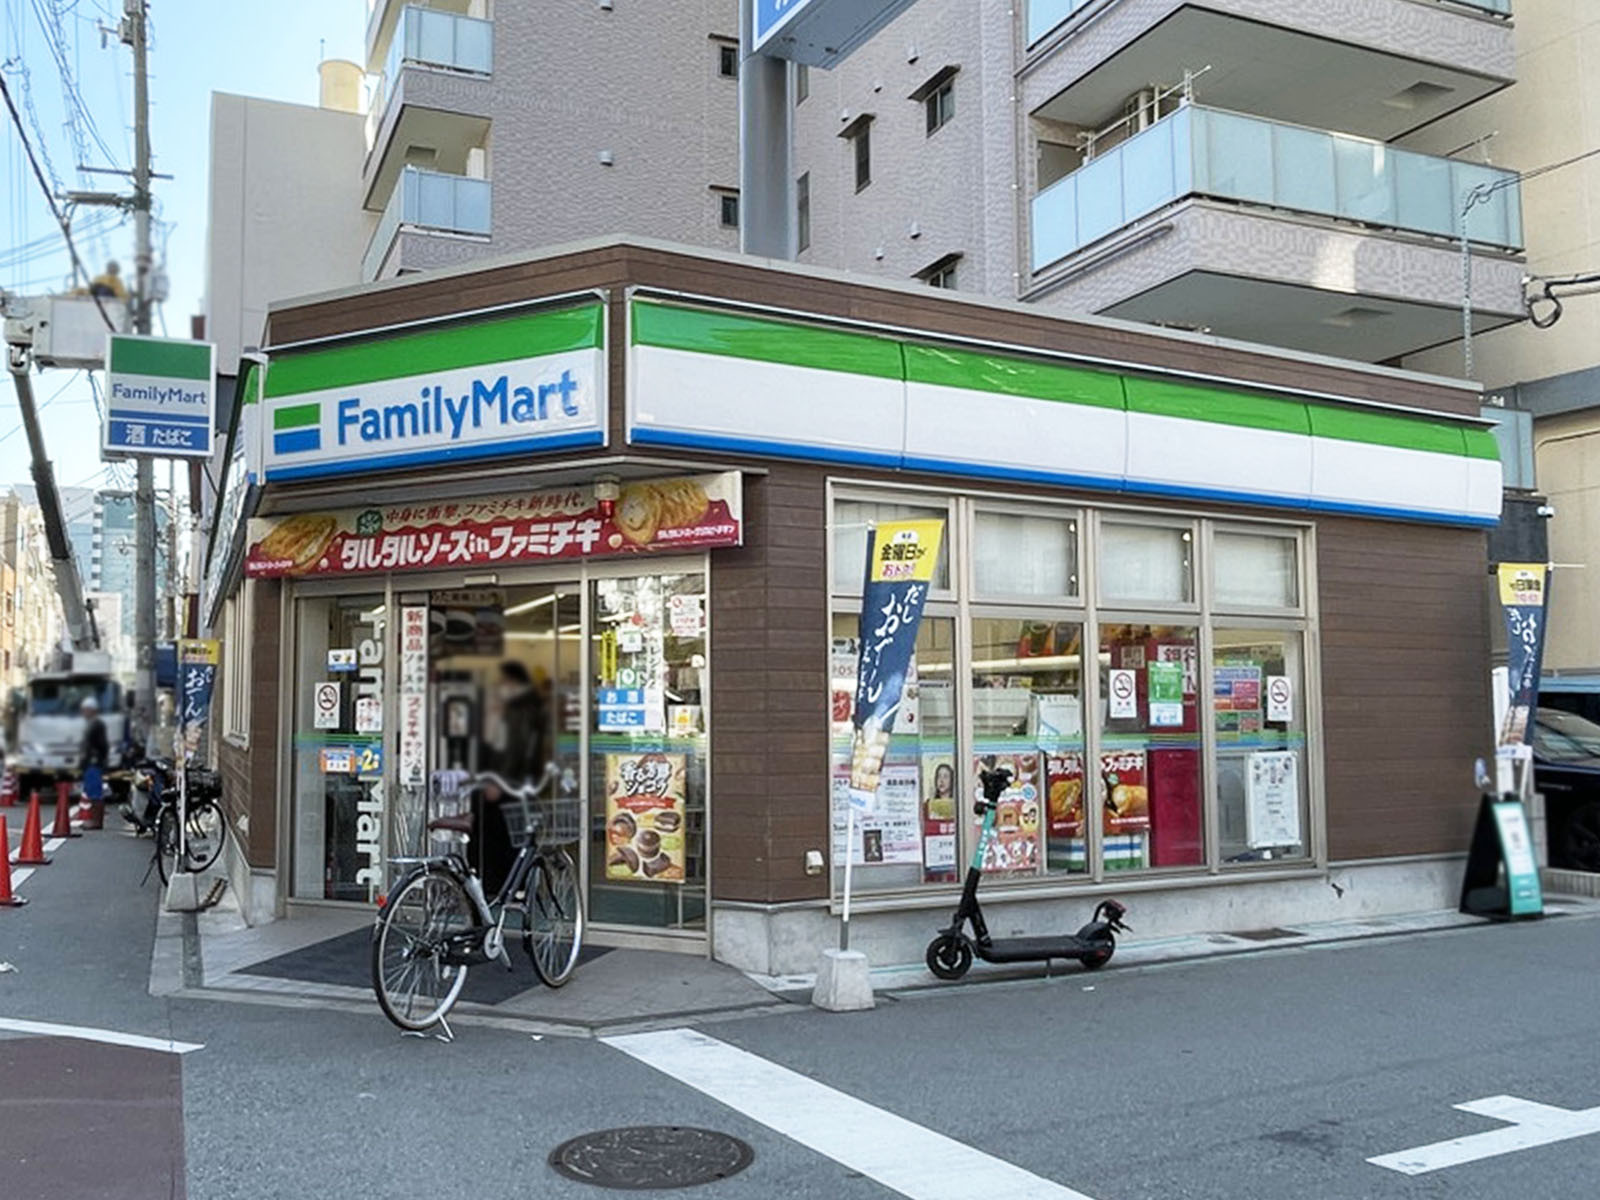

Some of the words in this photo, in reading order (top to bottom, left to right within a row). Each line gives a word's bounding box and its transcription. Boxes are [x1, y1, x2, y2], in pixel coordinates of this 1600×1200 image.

[112, 383, 206, 405] FamilyMart
[338, 370, 578, 446] FamilyMart
[125, 424, 146, 445] 酒
[152, 428, 193, 446] たばこ
[340, 517, 603, 571] タルタルソースinファミチキ
[880, 544, 927, 561] 金曜日が
[406, 609, 424, 652] 新商品
